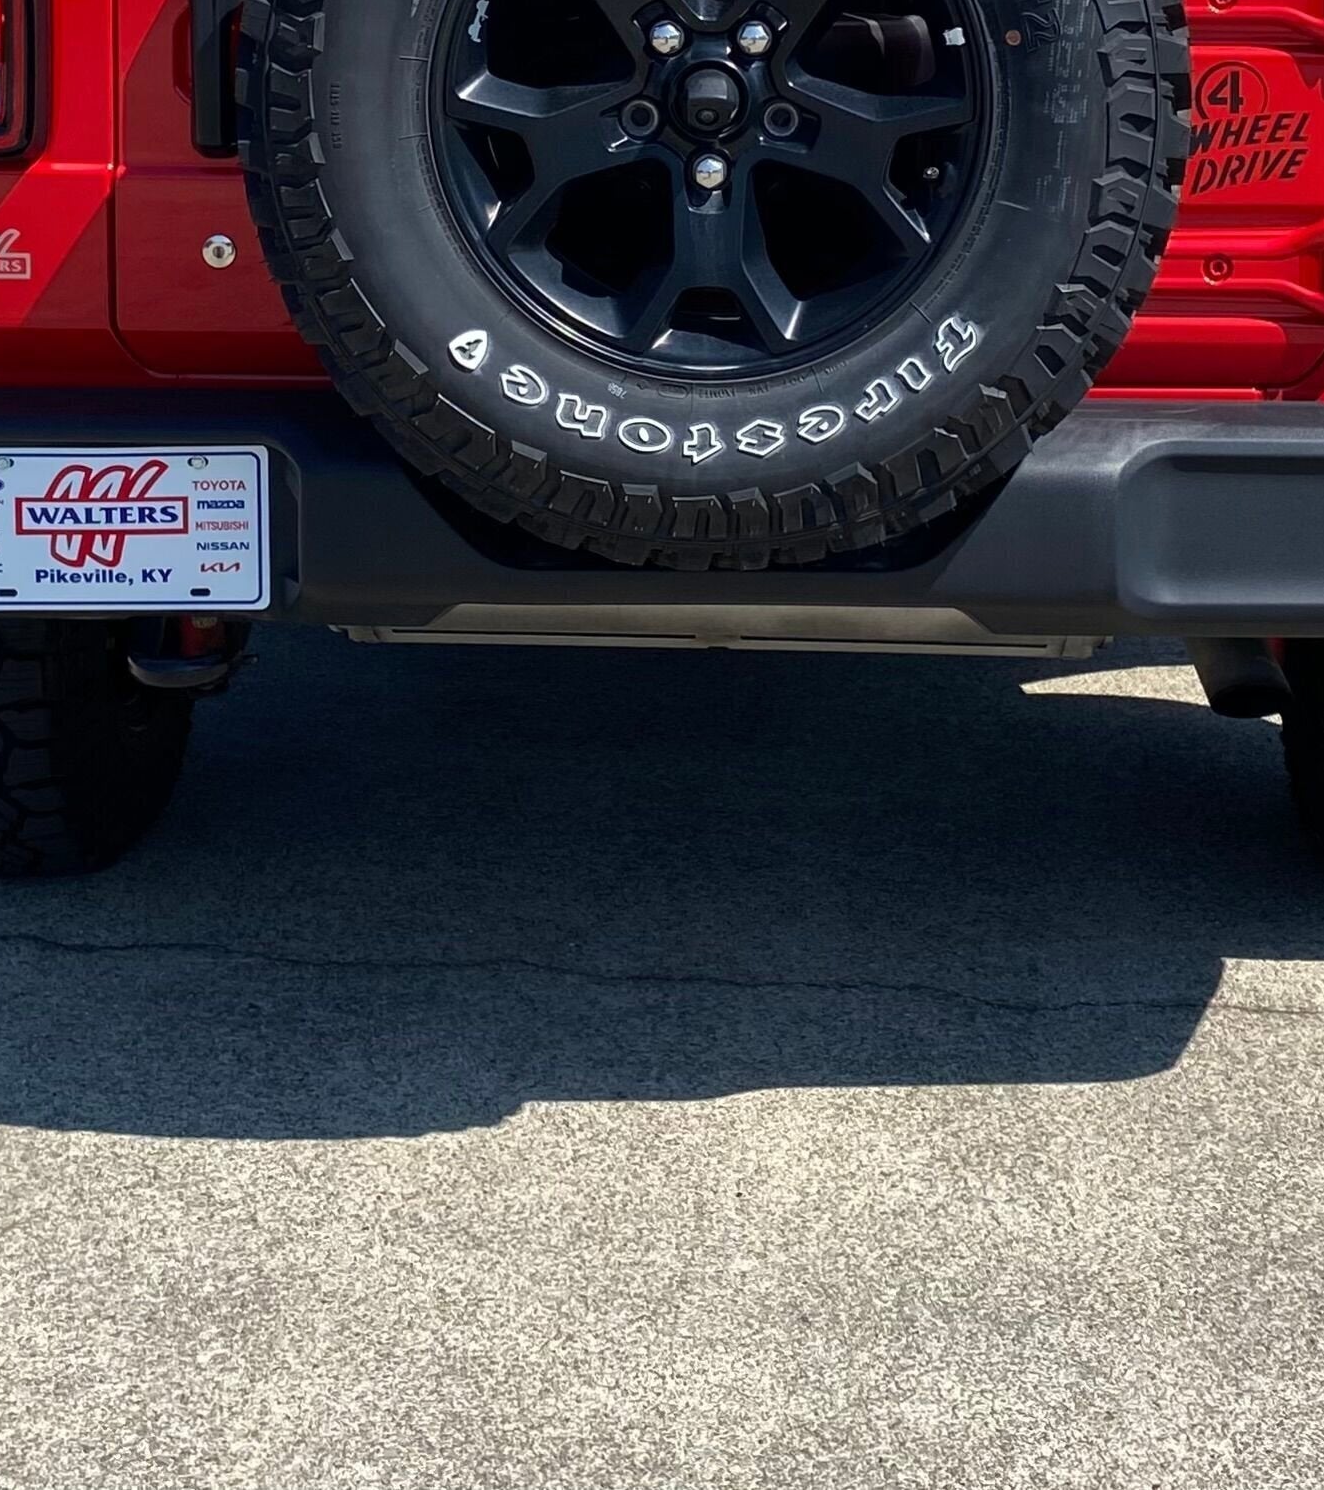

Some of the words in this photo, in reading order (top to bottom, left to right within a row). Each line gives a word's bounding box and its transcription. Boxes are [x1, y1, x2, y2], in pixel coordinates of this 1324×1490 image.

[1207, 70, 1244, 114] 4
[1190, 112, 1311, 157] WHEEL
[1190, 149, 1309, 196] DRIVE
[500, 314, 979, 464] Firestone
[192, 480, 247, 492] TOYOTA
[27, 505, 179, 526] WALTERS
[195, 520, 250, 531] MITSUBISHI
[196, 541, 250, 552] NISSAN
[35, 568, 134, 586] Pikeville,
[141, 567, 173, 583] KY
